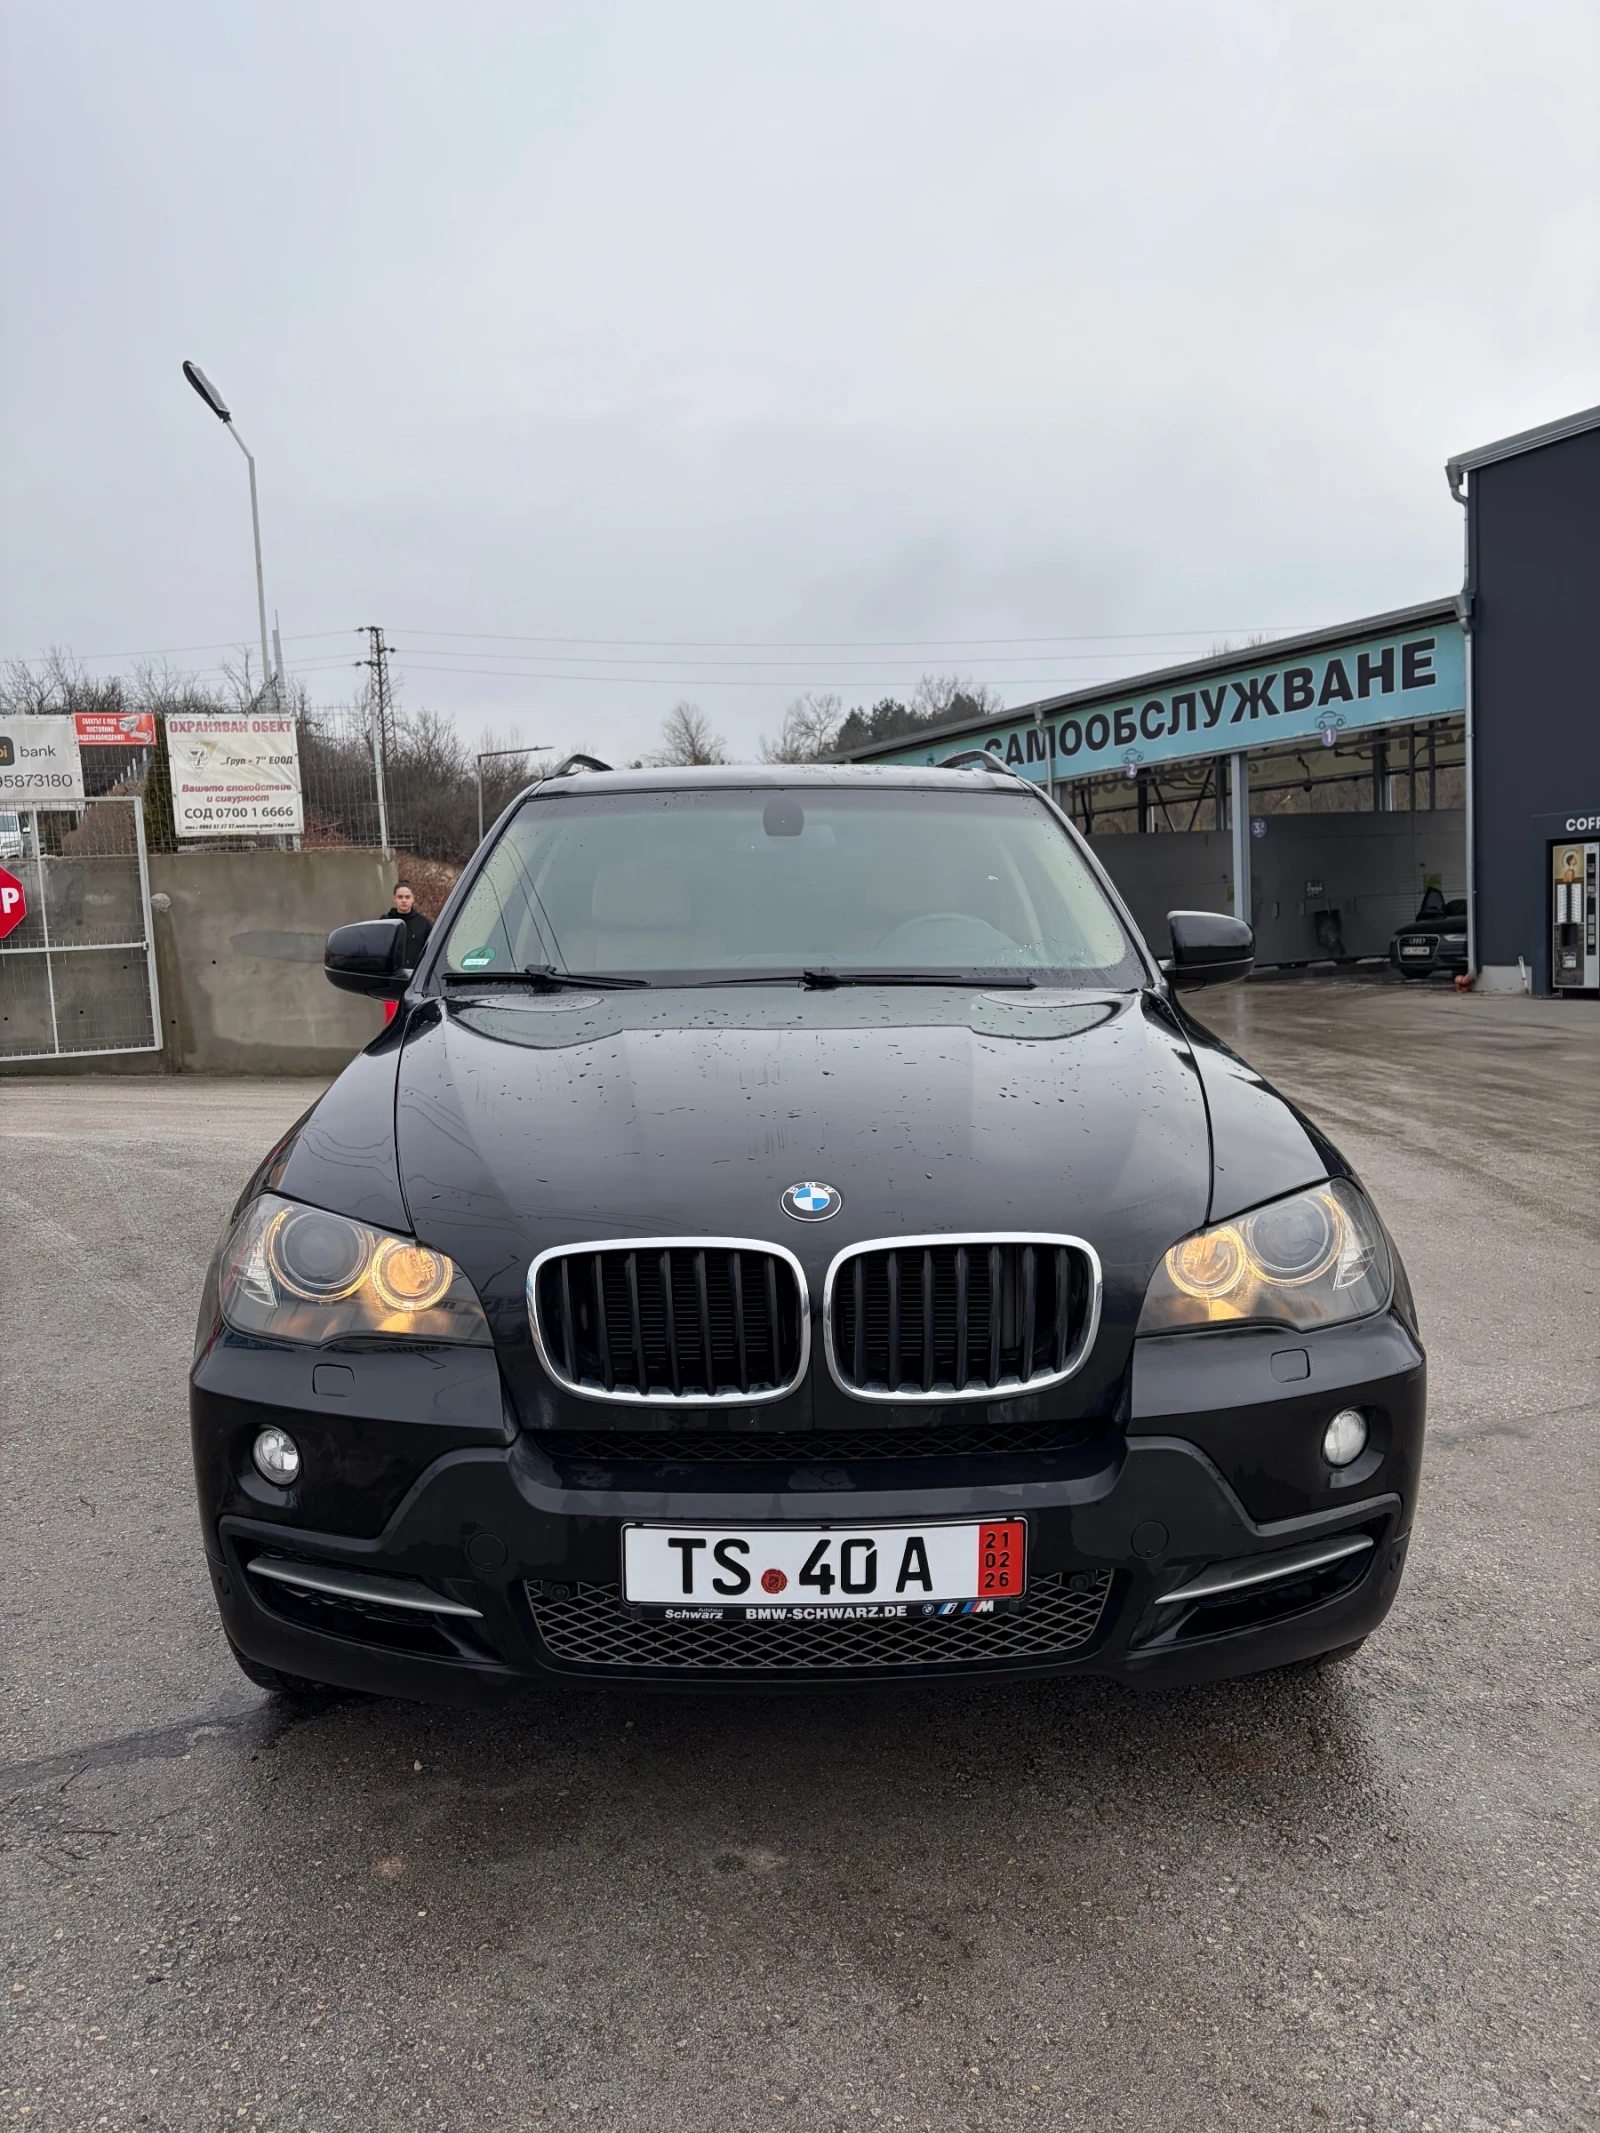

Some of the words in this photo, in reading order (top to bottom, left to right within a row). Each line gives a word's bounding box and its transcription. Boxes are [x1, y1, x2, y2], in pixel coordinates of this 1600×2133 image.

[169, 720, 249, 733] ОХРАНЯВАН
[252, 720, 292, 733] ОБЕКТ
[1326, 729, 1332, 743] 1
[20, 744, 57, 757] bank
[269, 756, 293, 765] ЕООД
[181, 784, 224, 792] Вашето
[226, 783, 292, 791] спокойствие
[215, 794, 270, 804] сигурност
[184, 807, 213, 820] СОД
[216, 807, 248, 818] 0700
[252, 807, 257, 818] 1
[261, 806, 294, 817] 6666
[985, 1532, 1009, 1549] 21
[668, 1537, 751, 1596] TS
[799, 1538, 877, 1595] 40
[896, 1536, 933, 1593] A
[985, 1551, 1010, 1568] 02
[984, 1572, 1009, 1588] 26
[664, 1609, 724, 1619] Schwarz
[745, 1605, 908, 1620] BMW-SCHWARZ.DE
